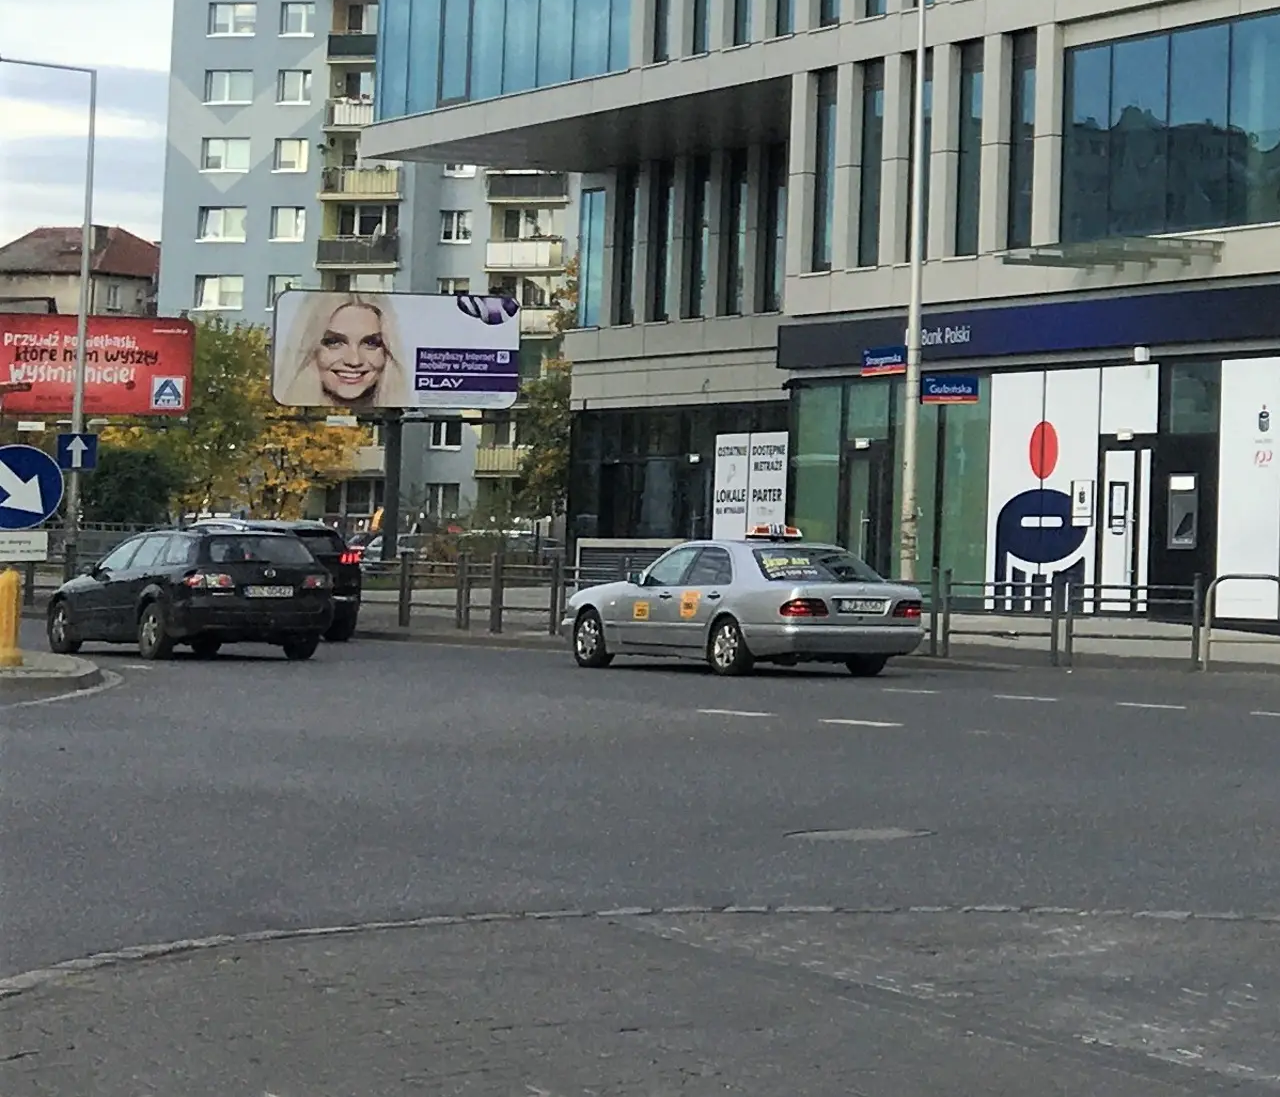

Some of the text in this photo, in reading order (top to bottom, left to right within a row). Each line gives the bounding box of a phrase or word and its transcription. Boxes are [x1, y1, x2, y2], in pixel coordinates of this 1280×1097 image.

[921, 325, 971, 345] Bank Polski
[418, 377, 463, 389] PLAY
[716, 489, 746, 503] LOKALE
[752, 489, 782, 502] PARTER
